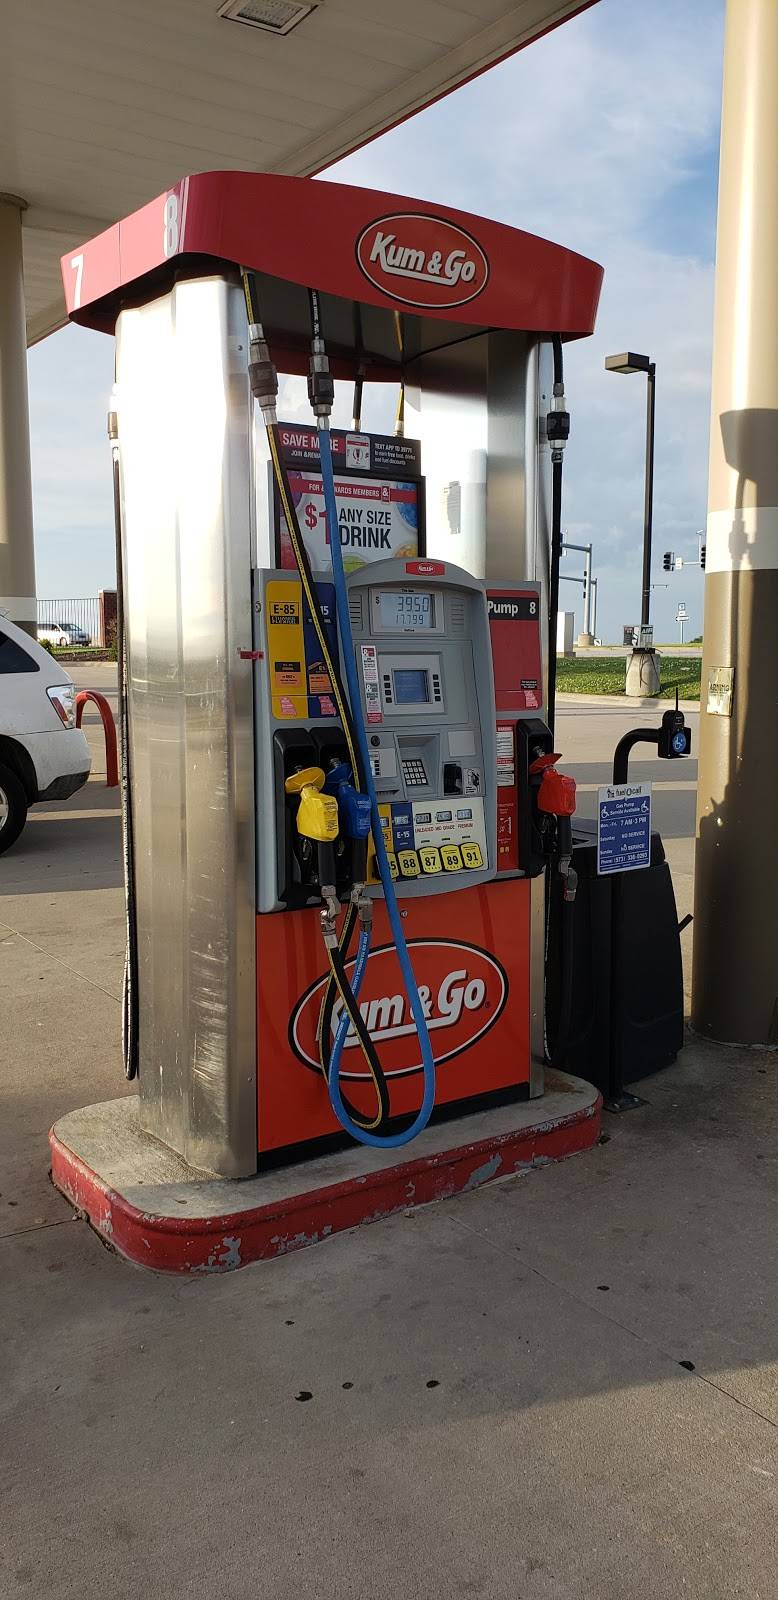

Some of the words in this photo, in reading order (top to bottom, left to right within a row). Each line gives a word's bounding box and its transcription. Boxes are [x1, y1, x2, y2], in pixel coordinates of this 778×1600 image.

[163, 195, 178, 257] 8
[370, 232, 426, 272] Kum
[427, 250, 442, 275] &
[444, 250, 476, 286] Go
[69, 254, 84, 310] 7
[282, 433, 308, 448] SAVE
[311, 436, 338, 450] MRE
[353, 488, 380, 497] MEMBERS
[339, 508, 362, 524] ANY
[367, 511, 392, 525] SIZE
[339, 525, 392, 549] DRINK
[274, 605, 295, 614] E-85
[487, 601, 518, 616] Pump
[530, 602, 536, 614] 8
[390, 861, 396, 870] 5
[403, 858, 416, 868] 88
[425, 857, 436, 866] 87
[447, 856, 458, 865] 89
[467, 852, 478, 861] 91
[438, 970, 486, 1019] Go
